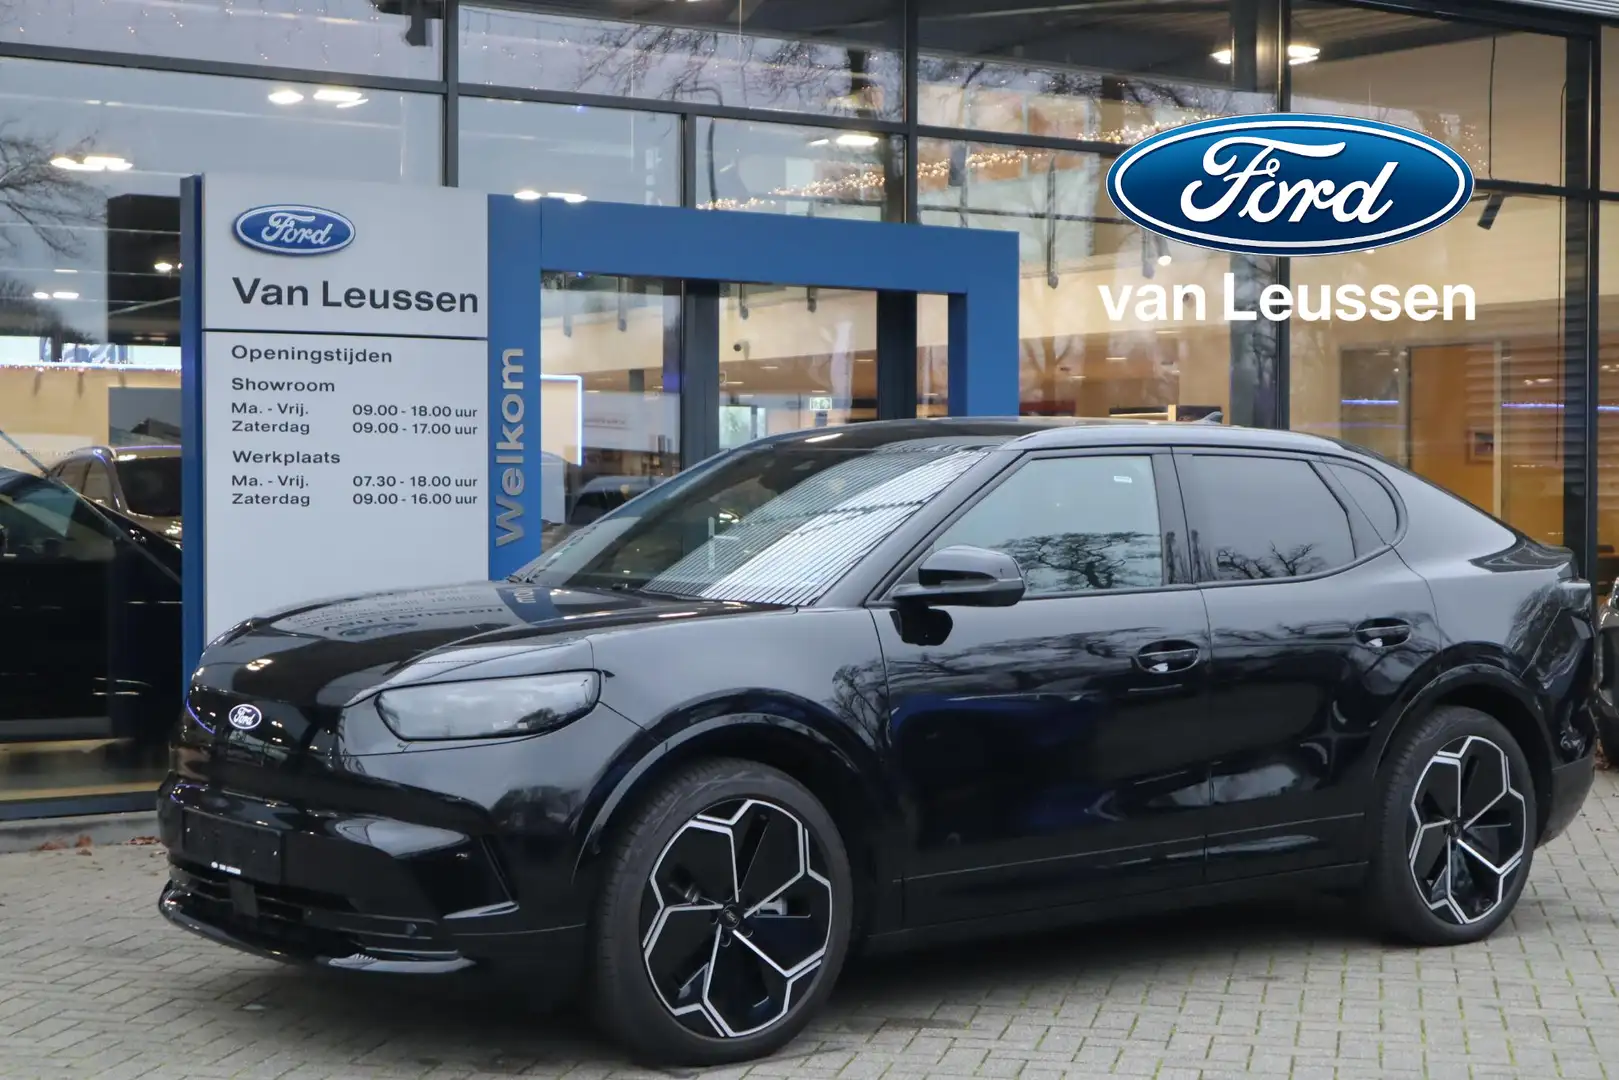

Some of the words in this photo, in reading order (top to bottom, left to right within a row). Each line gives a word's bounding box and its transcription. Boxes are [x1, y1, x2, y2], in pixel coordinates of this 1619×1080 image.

[261, 212, 333, 246] Ford
[231, 276, 309, 306] Van
[322, 280, 479, 313] Leussen
[231, 344, 393, 365] Openingstijden
[231, 377, 335, 392] Showroom
[231, 402, 263, 414] Ma.
[277, 402, 309, 418] Vrij.
[352, 403, 398, 417] 09.00
[411, 405, 452, 418] 18.00
[455, 408, 478, 418] uur
[231, 420, 310, 436] Zaterdag
[352, 422, 399, 434] 09.00
[412, 423, 452, 435] 17.00
[455, 426, 478, 435] uur
[495, 348, 525, 547] Welkom
[232, 450, 341, 466] Werkplaats
[231, 475, 263, 487] Ma.
[277, 475, 309, 490] Vrij.
[352, 475, 397, 488] 07.30
[410, 475, 452, 488] 18.00
[455, 478, 478, 488] uur
[231, 492, 310, 508] Zaterdag
[352, 493, 399, 505] 09.00
[411, 493, 452, 505] 16.00
[455, 496, 478, 505] uur
